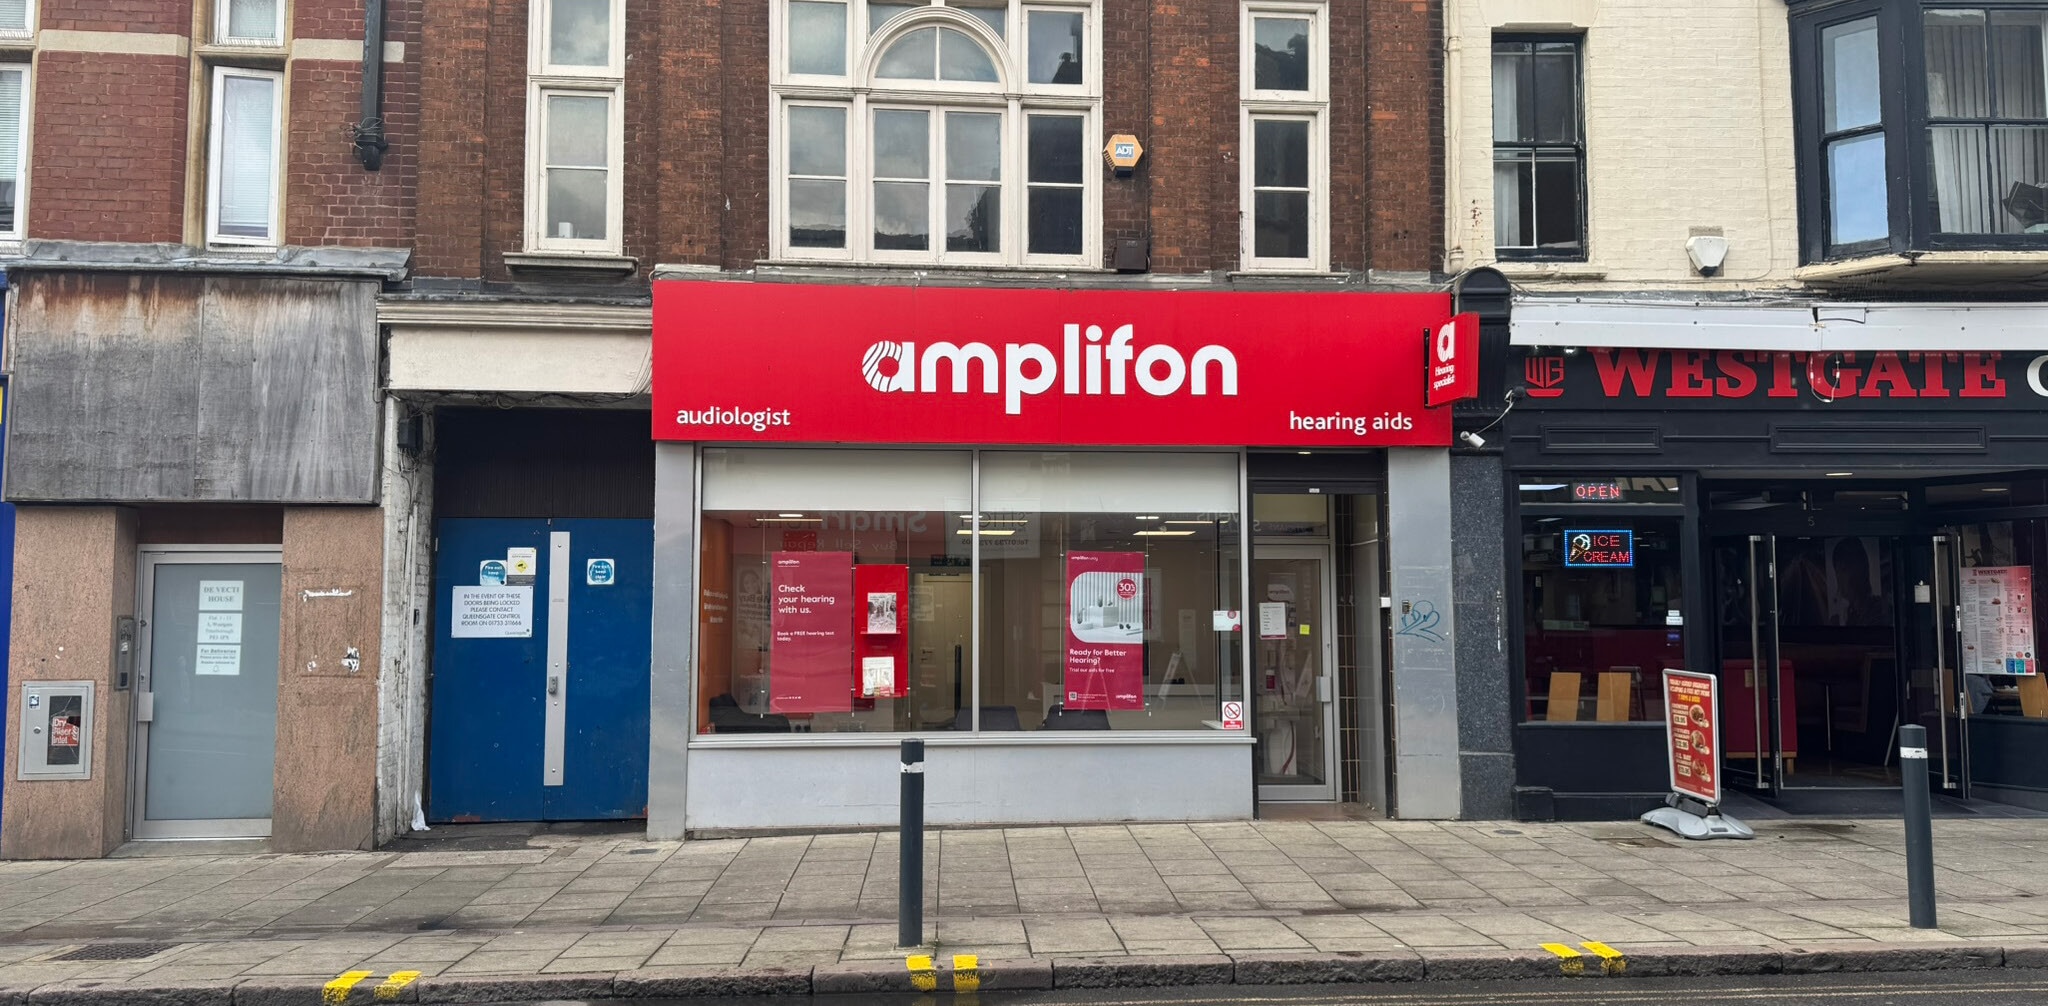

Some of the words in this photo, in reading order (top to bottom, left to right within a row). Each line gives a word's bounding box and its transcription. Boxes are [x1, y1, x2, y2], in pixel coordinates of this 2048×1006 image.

[1116, 146, 1134, 155] ADT
[862, 324, 1239, 415] amplifon
[1588, 348, 2006, 398] WESTGATE
[677, 407, 791, 431] audiologist
[1290, 410, 1367, 436] hearing
[1372, 411, 1413, 430] aids
[1576, 486, 1620, 497] OPEN
[1807, 515, 1815, 527] 5
[1593, 535, 1620, 547] ICE
[1583, 551, 1630, 563] CREAM
[778, 584, 805, 593] Check
[778, 596, 798, 605] your
[801, 595, 835, 605] hearing
[1069, 648, 1091, 656] Ready
[1069, 657, 1101, 665] Hearing?
[55, 719, 67, 727] Dry
